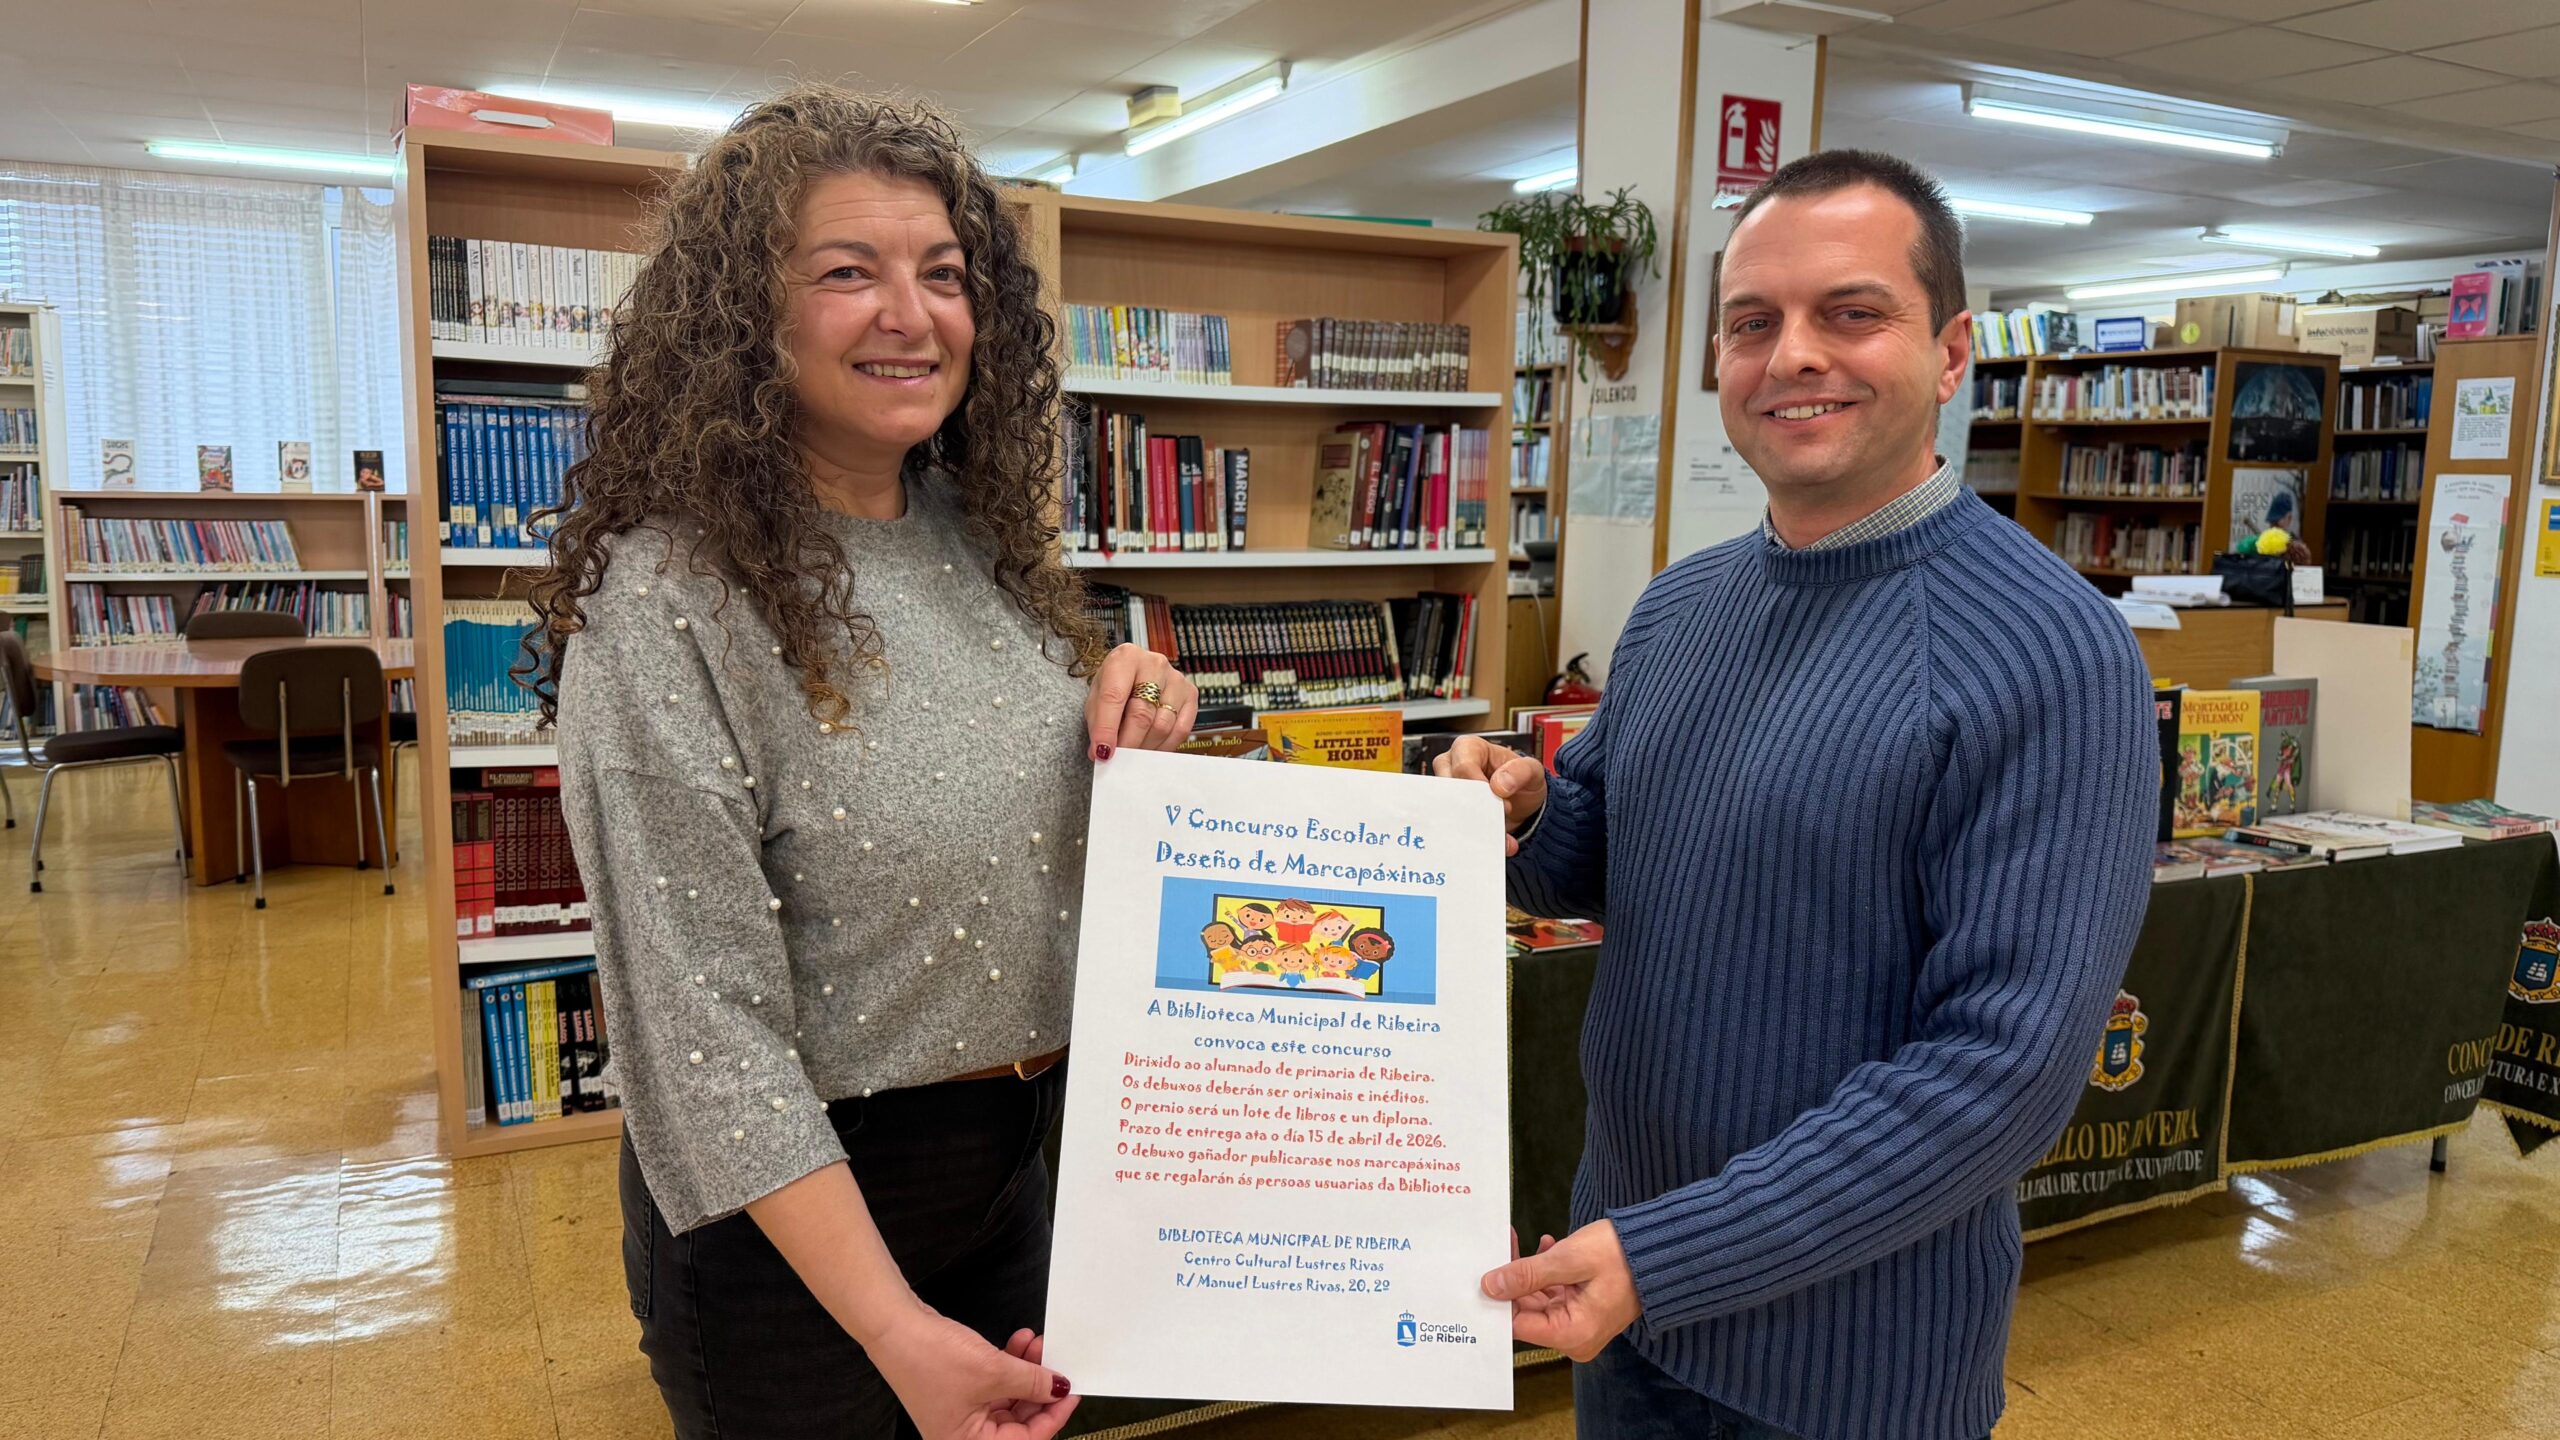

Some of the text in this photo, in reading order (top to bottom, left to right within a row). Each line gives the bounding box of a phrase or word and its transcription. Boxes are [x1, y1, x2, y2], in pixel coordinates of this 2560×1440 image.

[1234, 455, 1248, 513] MARCH
[2183, 700, 2249, 713] MORTADELO
[2188, 715, 2194, 725] Y
[1314, 736, 1391, 749] LITTLE BIG
[1327, 748, 1378, 761] HORN
[1166, 805, 1425, 849] V Concurso Escolar de
[1156, 841, 1445, 886] Deseño de Marcapáxinas
[1147, 1000, 1440, 1032] A Biblioteca Municipal de Ribeira
[1194, 1037, 1391, 1057] convoca este concurso
[2495, 1022, 2533, 1058] DE
[1125, 1052, 1434, 1082] Dirixido ao alumnado de primaria de Ribeira.
[1123, 1075, 1139, 1089] Os
[1143, 1076, 1201, 1093] debuxos
[1206, 1080, 1263, 1095] deberán
[1267, 1088, 1289, 1097] ser
[1293, 1088, 1352, 1101] orixinais
[1369, 1089, 1428, 1104] inéditos.
[2536, 1072, 2549, 1092] E
[1121, 1097, 1131, 1110] O
[1134, 1102, 1184, 1115] premio
[1188, 1104, 1218, 1115] será
[1244, 1104, 1270, 1119] lote
[1275, 1106, 1291, 1120] de
[1296, 1107, 1335, 1122] libros
[1340, 1114, 1347, 1123] e
[1352, 1115, 1369, 1123] un
[1373, 1110, 1432, 1128] diploma.
[1120, 1119, 1446, 1148] Prazo de entrega ata o día 15 de abril de 2026.
[2100, 1120, 2130, 1159] DE
[1117, 1142, 1128, 1155] O
[1132, 1143, 1184, 1159] debuxo
[1188, 1147, 1247, 1163] gañador
[1337, 1158, 1360, 1167] nos
[1365, 1158, 1460, 1173] marcapáxinas
[1115, 1169, 1471, 1194] que se regalarán ás persoas usuarias da Biblioteca
[1159, 1228, 1411, 1250] BIBLIOTECA MUNICIPAL DE RIBEIRA
[1184, 1251, 1383, 1271] Centro Cultural Lustres Rivas
[1253, 1276, 1302, 1291] Lustres
[1420, 1322, 1468, 1333] Concello
[1420, 1332, 1477, 1344] de Ribeira
